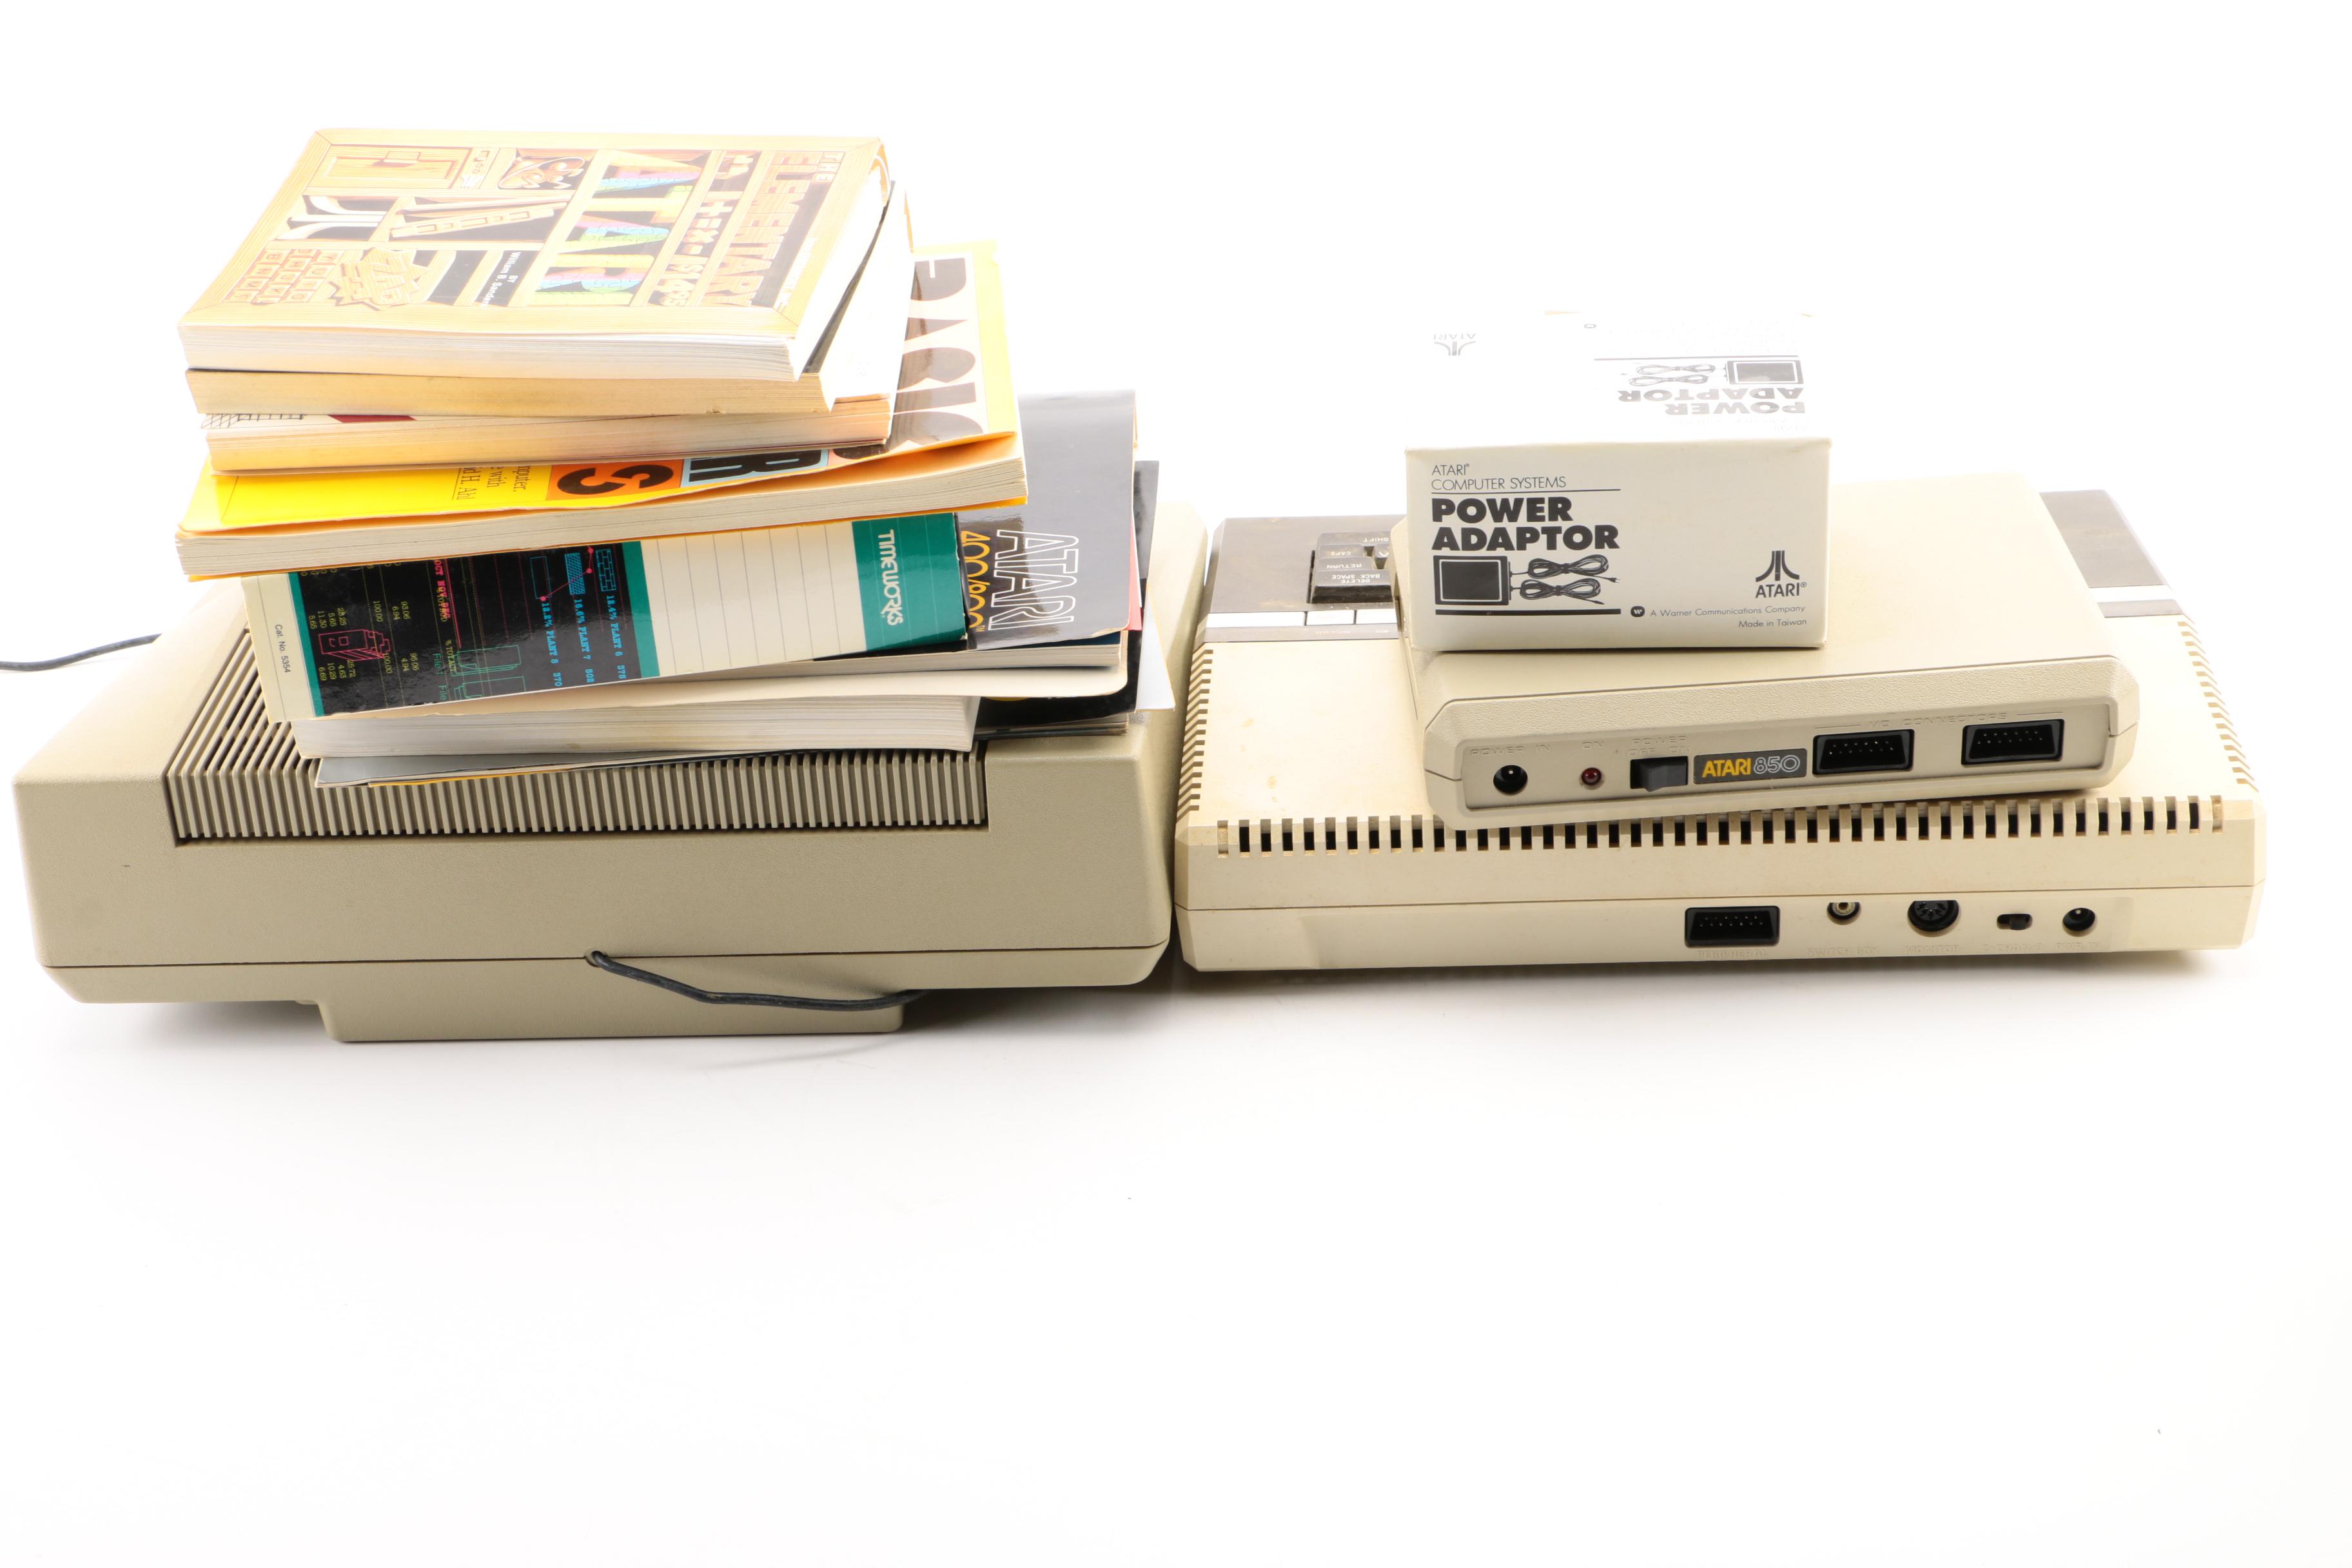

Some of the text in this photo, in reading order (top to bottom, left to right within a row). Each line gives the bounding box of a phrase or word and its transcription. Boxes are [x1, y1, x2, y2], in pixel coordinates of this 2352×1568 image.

[525, 150, 703, 306] ATARI
[701, 152, 823, 308] ELEMENTARY
[500, 251, 522, 273] William
[507, 275, 518, 284] BY
[1617, 387, 1805, 403] ADAPTOR
[1664, 401, 1807, 416] POWER
[460, 475, 481, 485] H.
[486, 471, 507, 487] with
[1431, 476, 1567, 491] COMPUTER SYSTEMS
[456, 487, 478, 500] Ahl
[1431, 496, 1574, 524] POWER
[1431, 524, 1621, 551] ADAPTOR
[434, 559, 444, 576] OCT
[988, 529, 1080, 631] ATARI
[373, 600, 384, 622] 100.00
[1660, 609, 1692, 617] Warner
[1695, 608, 1763, 616] Communications
[1765, 605, 1806, 615] Company
[1738, 620, 1764, 628] Made
[1777, 618, 1807, 627] Taiwan
[546, 630, 558, 656] PLANT
[578, 626, 590, 652] PLANT
[611, 623, 622, 649] PLANT
[275, 624, 291, 672] Cat. No. 5354
[382, 652, 393, 674] 100.00
[433, 652, 444, 669] File
[438, 685, 448, 701] File
[1902, 712, 2008, 727] CONNECTORS
[1582, 740, 1604, 749] ON
[1632, 735, 1687, 746] POWER
[1470, 744, 1551, 756] POWER IN
[1627, 745, 1690, 758] OFF ON
[1702, 754, 1800, 778] ATARI 850
[1696, 948, 1769, 959] PERIPHERAL
[1856, 946, 1878, 955] BOX
[1905, 944, 1960, 954] MONITOR
